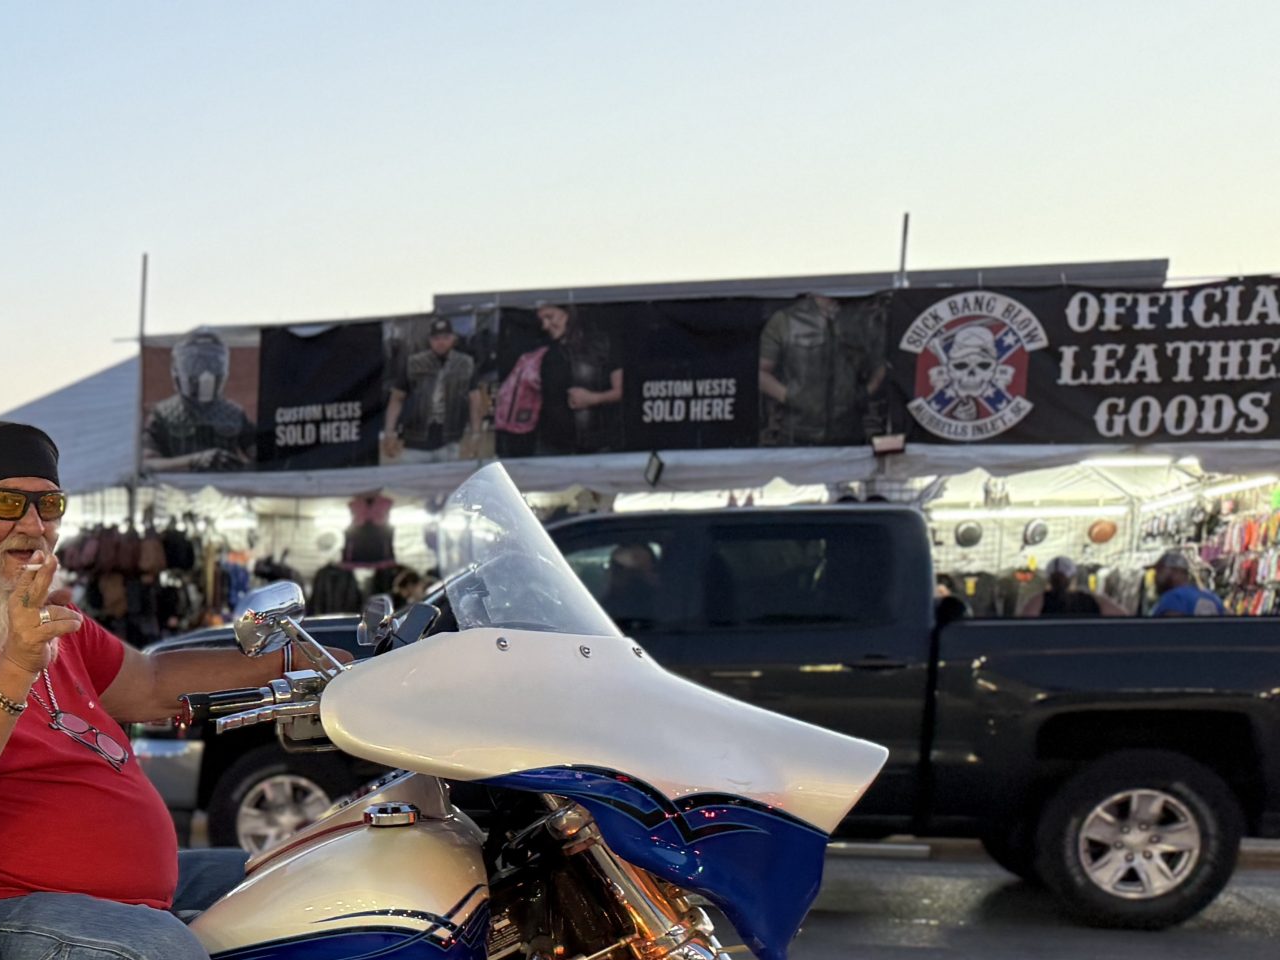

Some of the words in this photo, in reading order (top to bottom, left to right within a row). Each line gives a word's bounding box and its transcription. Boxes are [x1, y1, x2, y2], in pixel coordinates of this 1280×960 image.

[906, 310, 944, 348] SUCK
[948, 295, 997, 317] BANG
[1001, 302, 1044, 348] BLOW
[1056, 337, 1280, 386] LEATHE
[642, 379, 694, 398] CUSTOM
[696, 378, 737, 396] VESTS
[275, 404, 323, 424] CUSTOM
[324, 401, 362, 419] VESTS
[642, 399, 686, 423] SOLD
[689, 398, 735, 421] HERE
[1093, 391, 1271, 437] GOODS
[275, 422, 316, 446] SOLD
[319, 420, 360, 443] HERE
